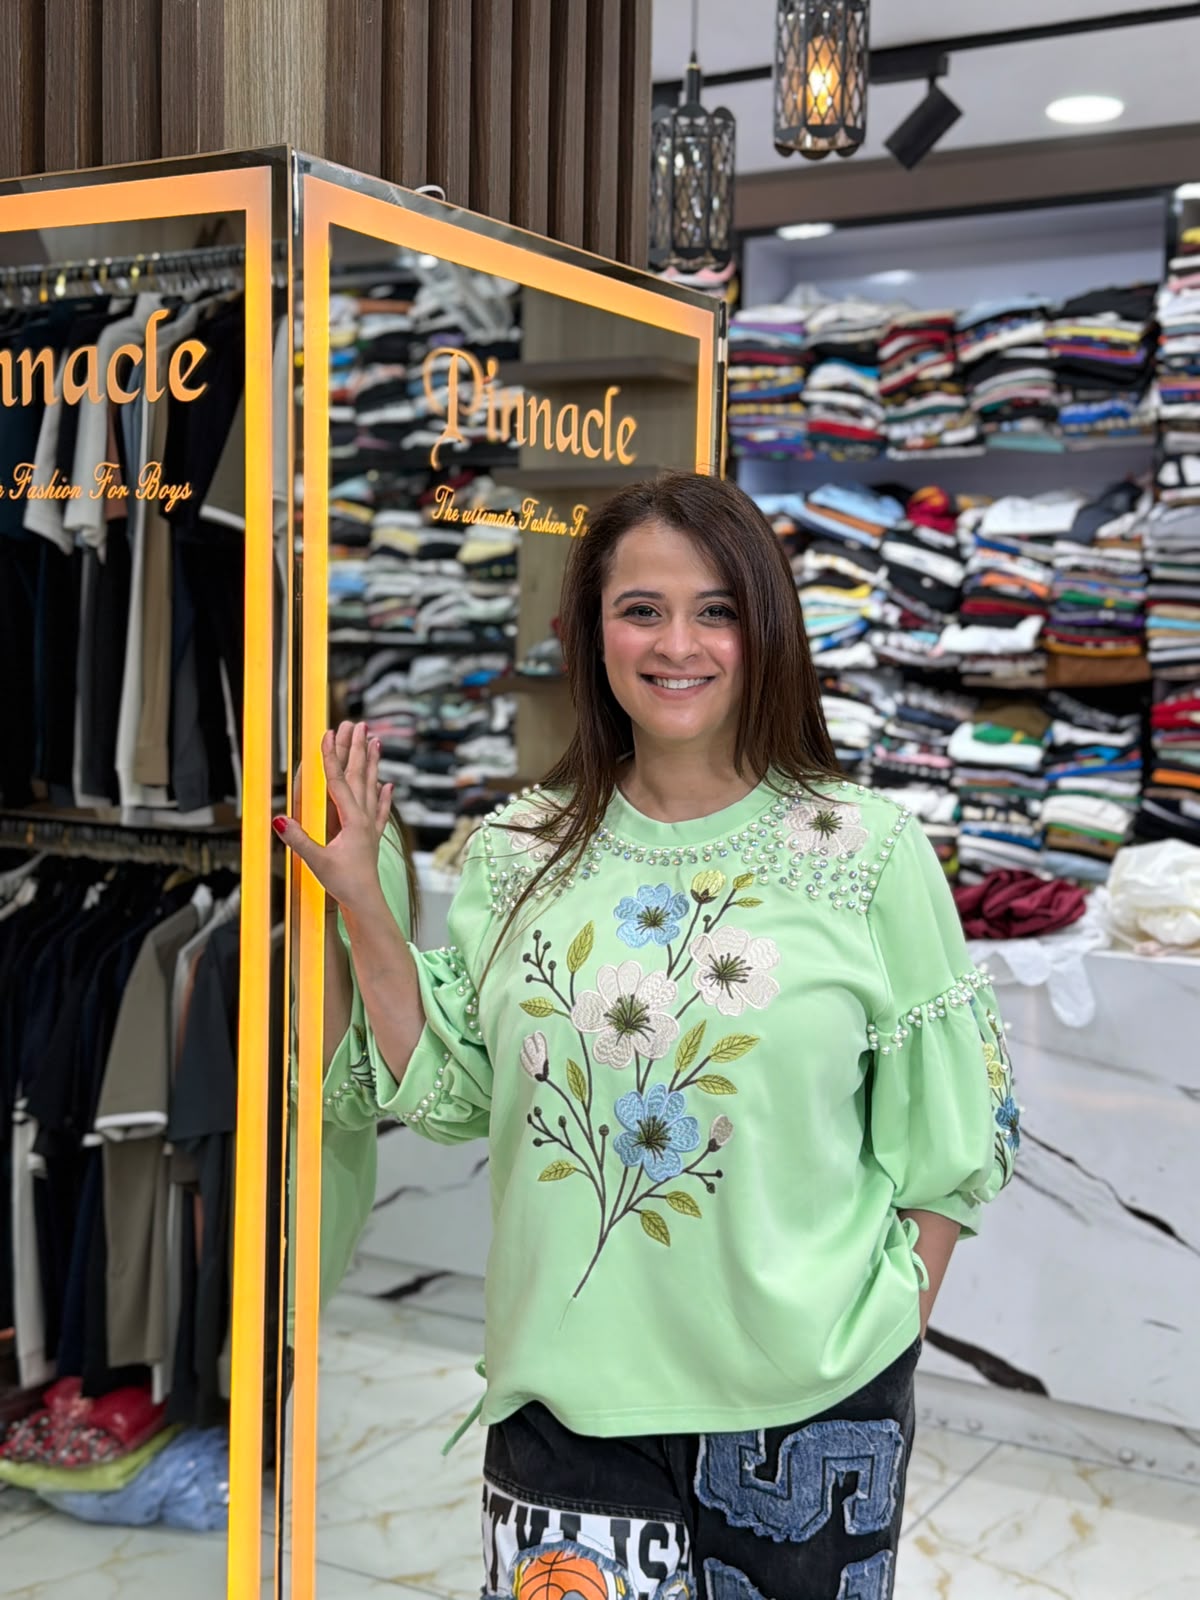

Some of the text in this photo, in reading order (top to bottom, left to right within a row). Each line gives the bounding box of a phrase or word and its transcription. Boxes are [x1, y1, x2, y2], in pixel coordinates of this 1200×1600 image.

[423, 347, 638, 470] Pinnacle
[9, 460, 192, 513] Fashion For Boys
[431, 485, 460, 522] The
[461, 504, 516, 529] ultimate
[518, 497, 568, 534] Fashion
